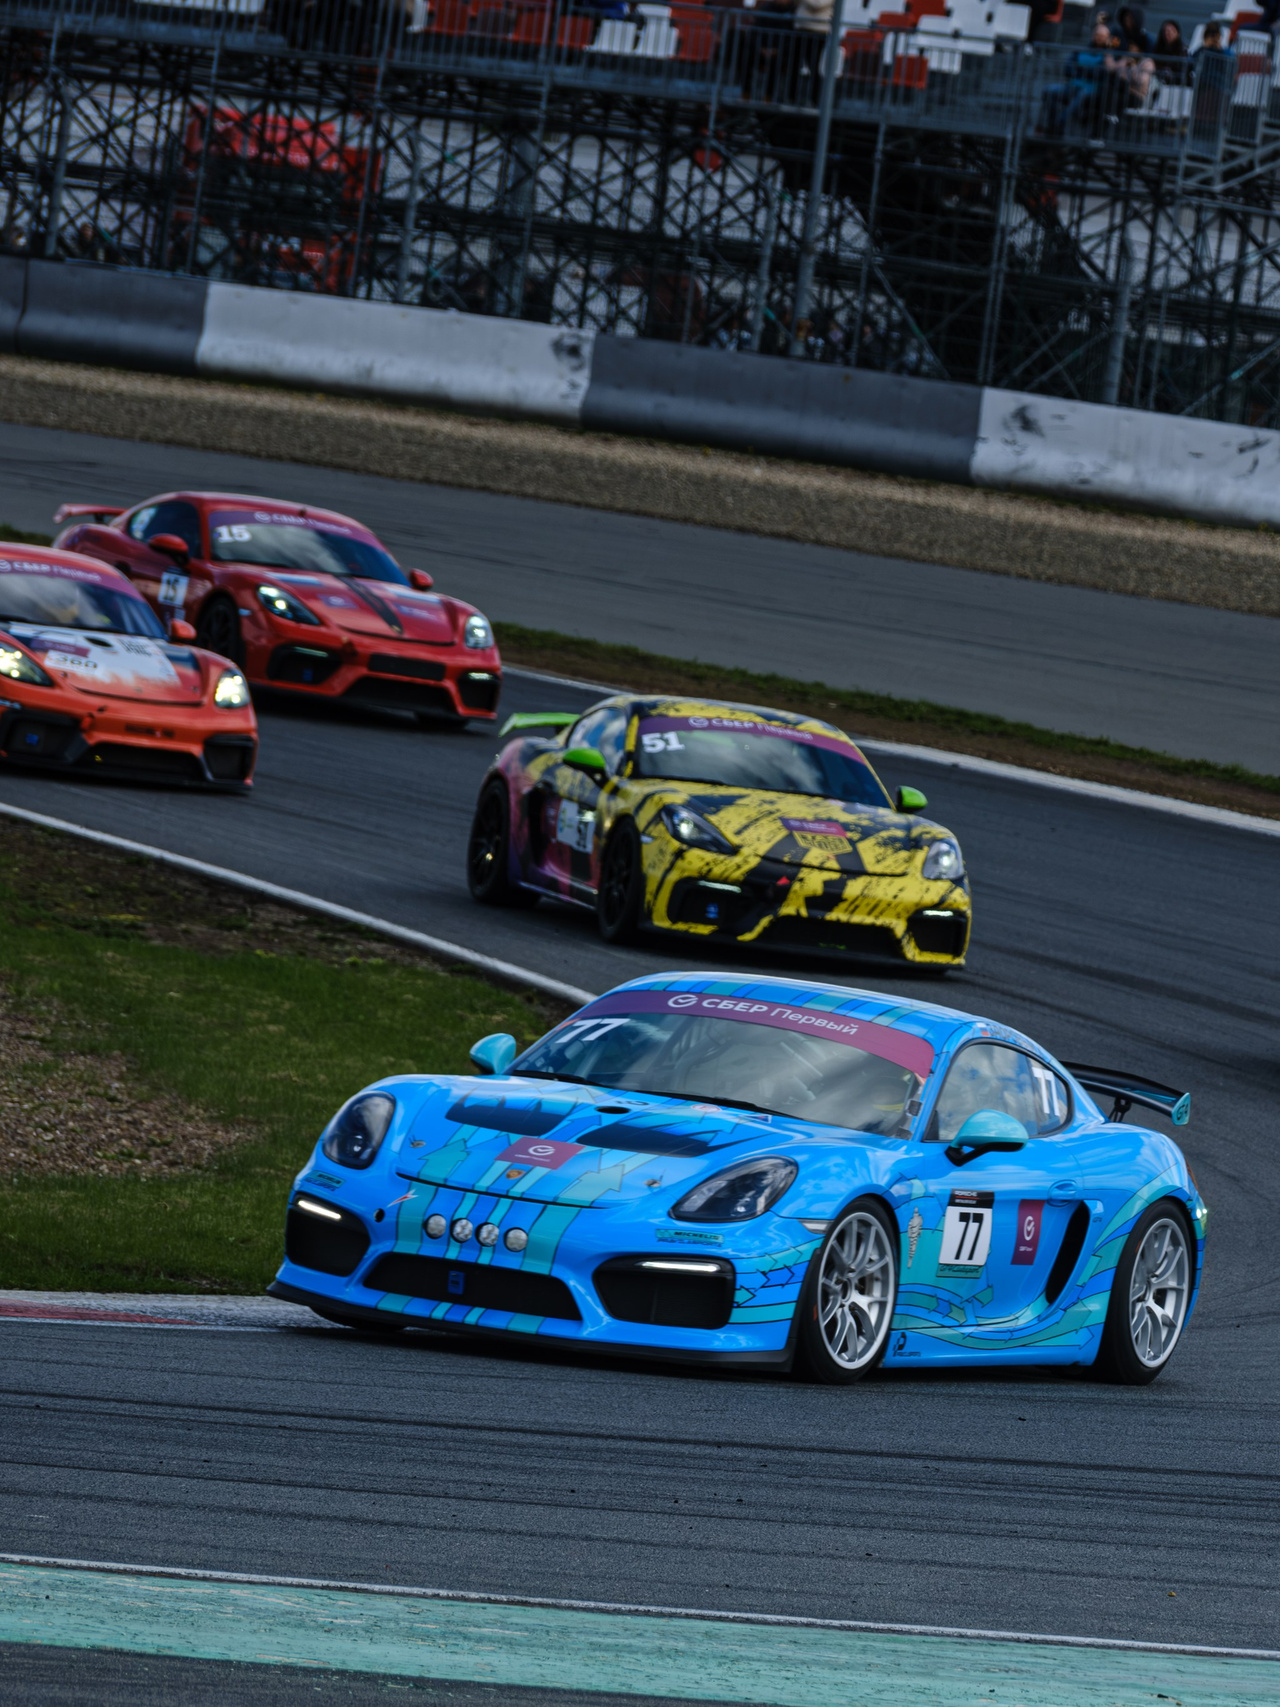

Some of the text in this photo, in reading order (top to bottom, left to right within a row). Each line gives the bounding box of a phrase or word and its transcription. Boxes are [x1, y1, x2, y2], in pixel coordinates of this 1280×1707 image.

[217, 525, 251, 543] 15
[163, 577, 179, 602] 15
[641, 731, 686, 754] 51
[701, 998, 860, 1036] СБЕР Первый
[554, 1017, 632, 1044] 77
[1031, 1066, 1061, 1117] 77
[674, 1231, 720, 1241] MICHELIN
[954, 1212, 984, 1261] 77
